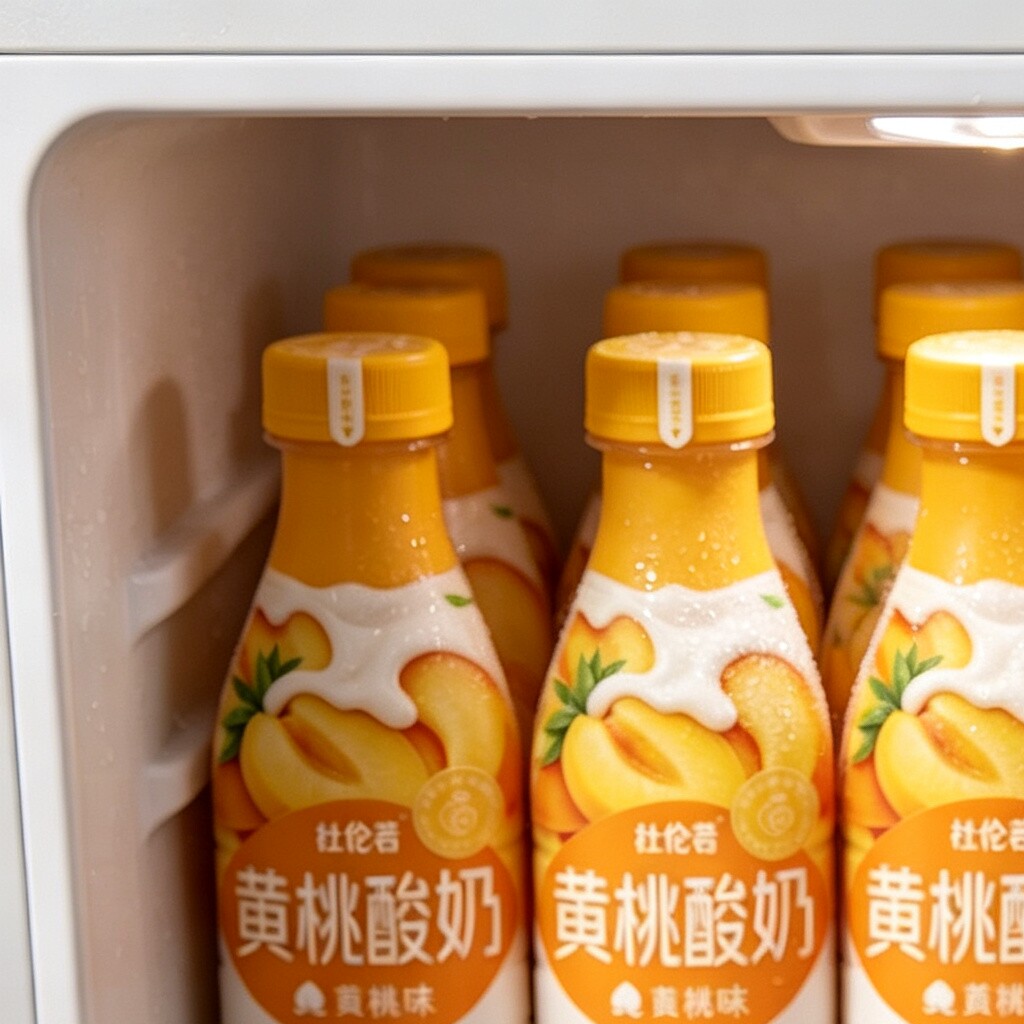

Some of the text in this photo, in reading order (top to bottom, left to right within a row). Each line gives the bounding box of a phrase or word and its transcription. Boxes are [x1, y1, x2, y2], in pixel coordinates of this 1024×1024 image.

[316, 820, 400, 855] 杜伦若
[634, 821, 719, 856] 杜伦若
[234, 864, 501, 968] 黄桃酸奶
[553, 865, 815, 969] 黄桃酸奶
[333, 982, 437, 1020] 黄桃味
[650, 982, 750, 1021] 黄桃味
